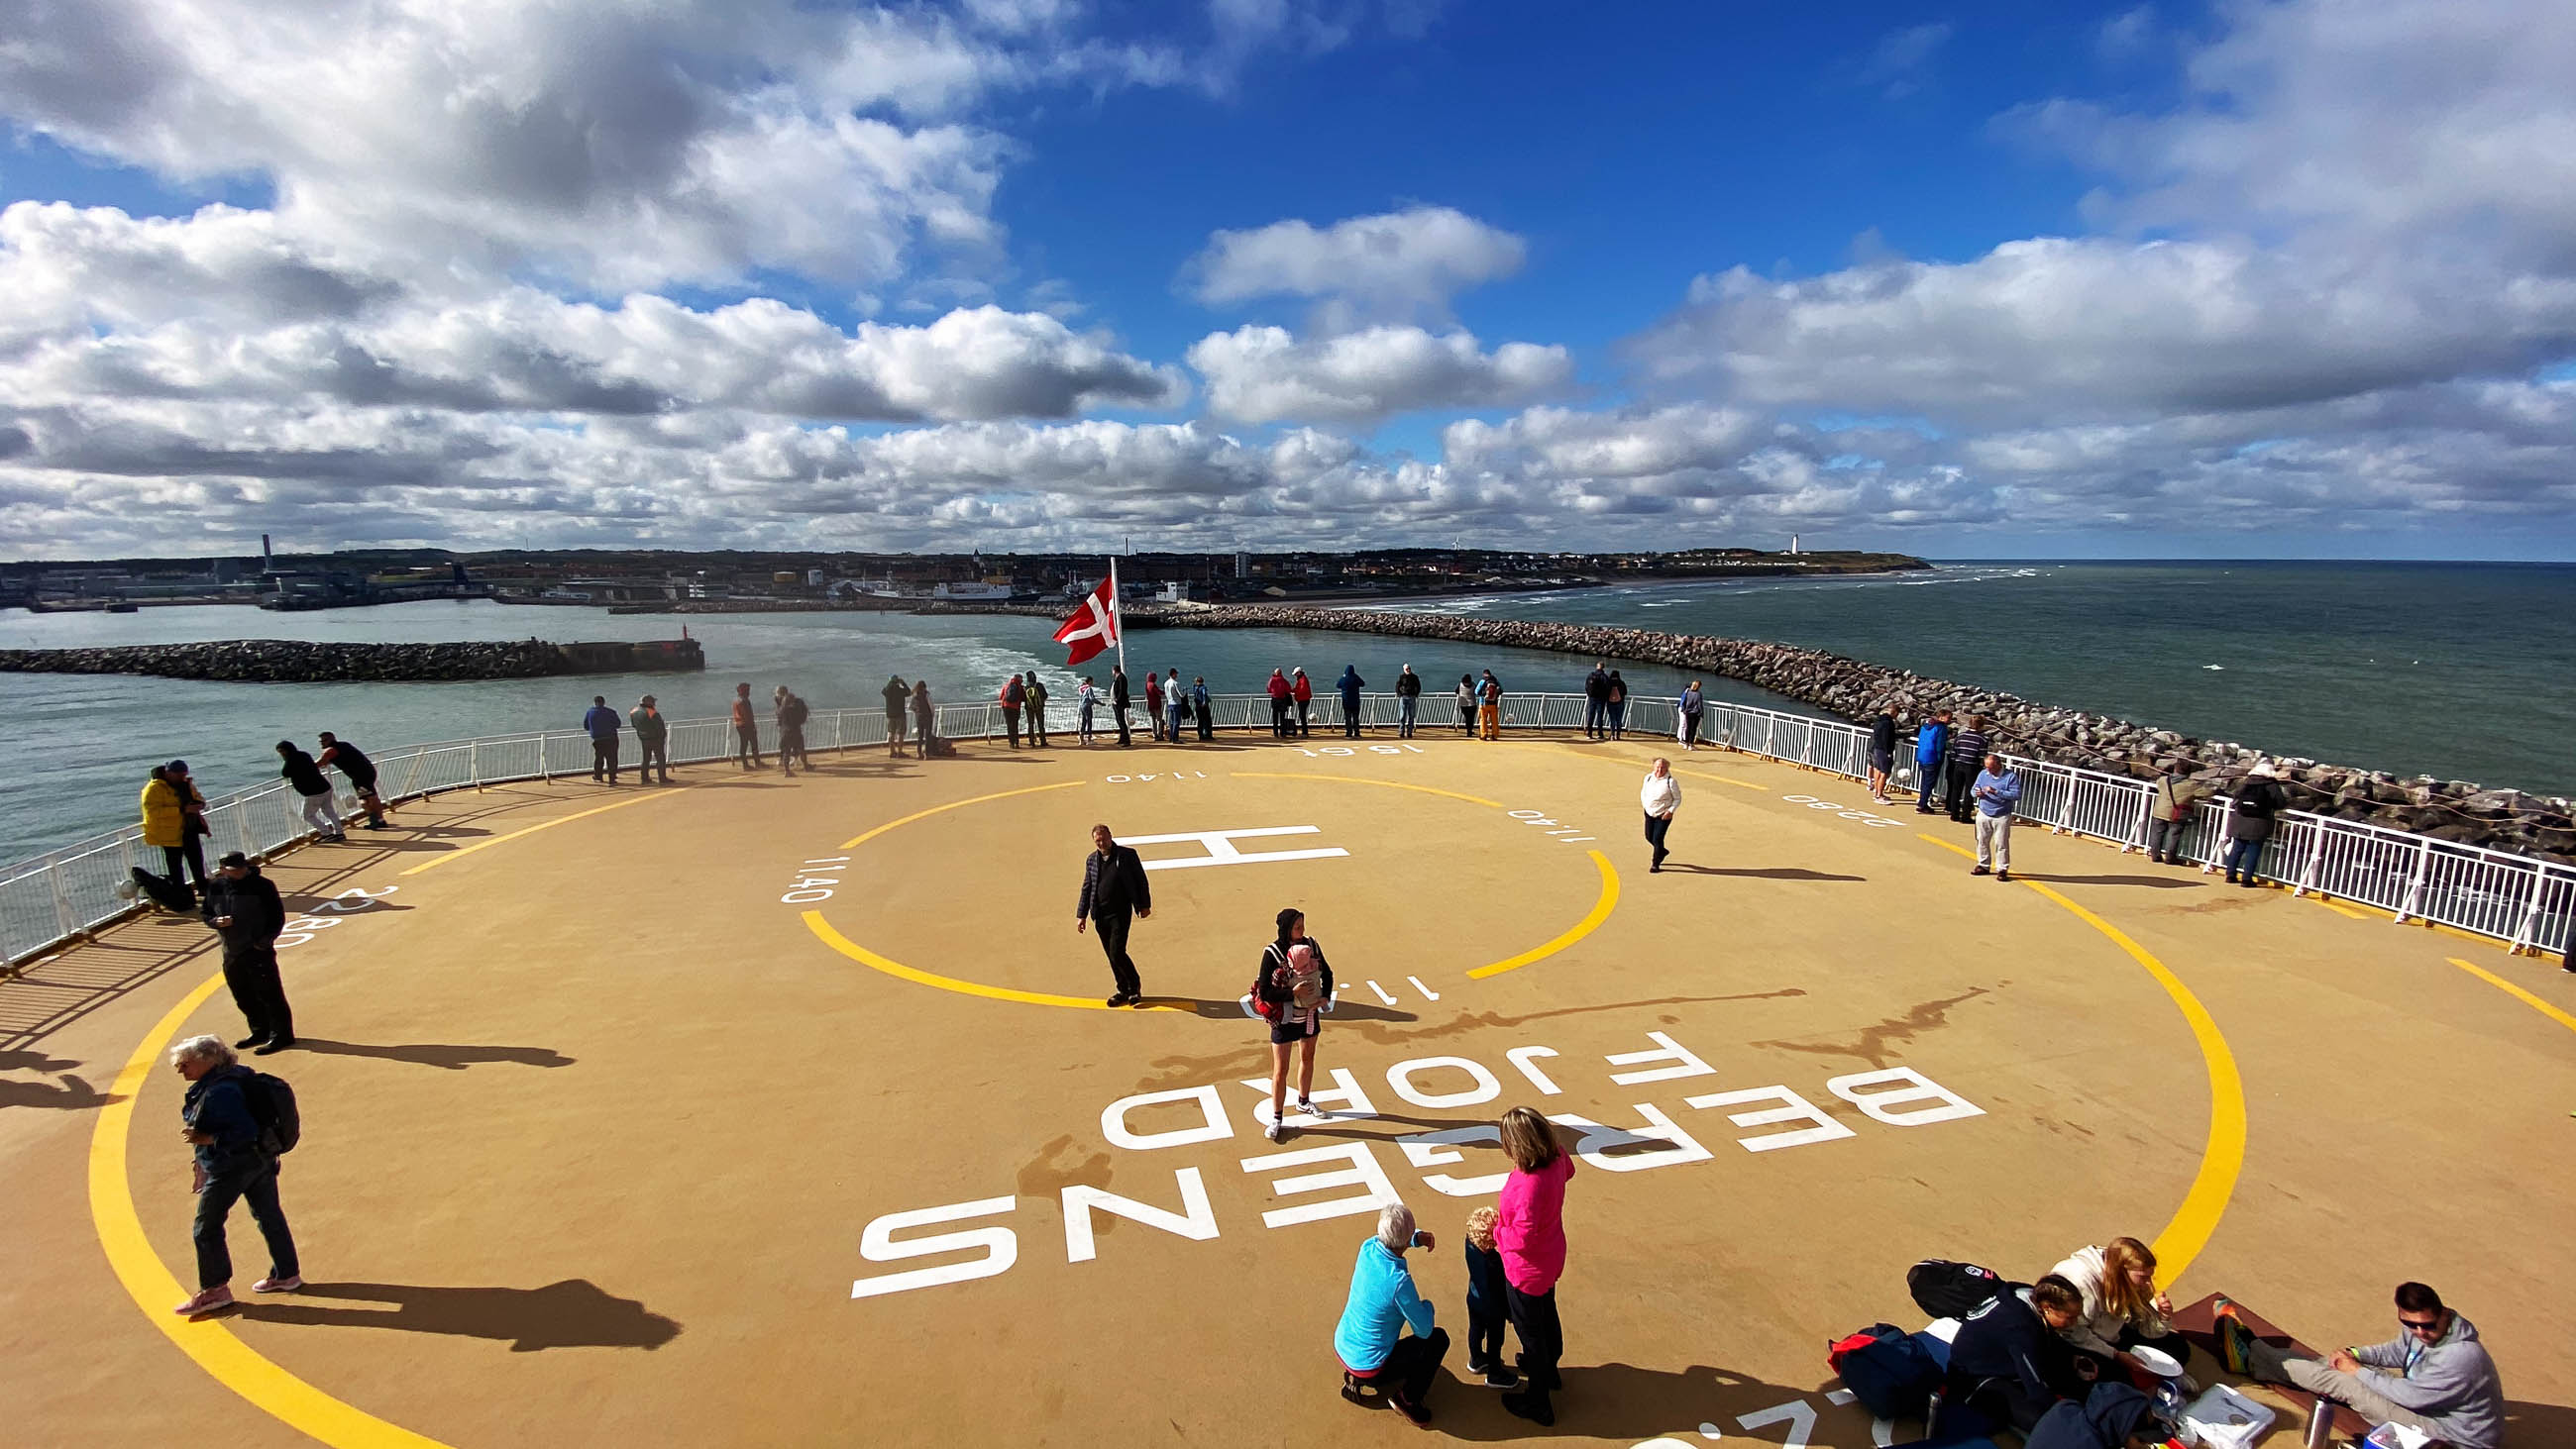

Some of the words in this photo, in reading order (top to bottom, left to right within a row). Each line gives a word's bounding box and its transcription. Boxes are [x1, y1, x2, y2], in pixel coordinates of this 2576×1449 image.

[1106, 771, 1207, 783] 11.40
[1507, 809, 1597, 842] 11.40
[1782, 794, 1906, 827] 22.80
[1111, 824, 1351, 871] H
[781, 856, 851, 903] 11.40
[1100, 1030, 1717, 1150] FJORD
[850, 1066, 1987, 1298] BERGENS
